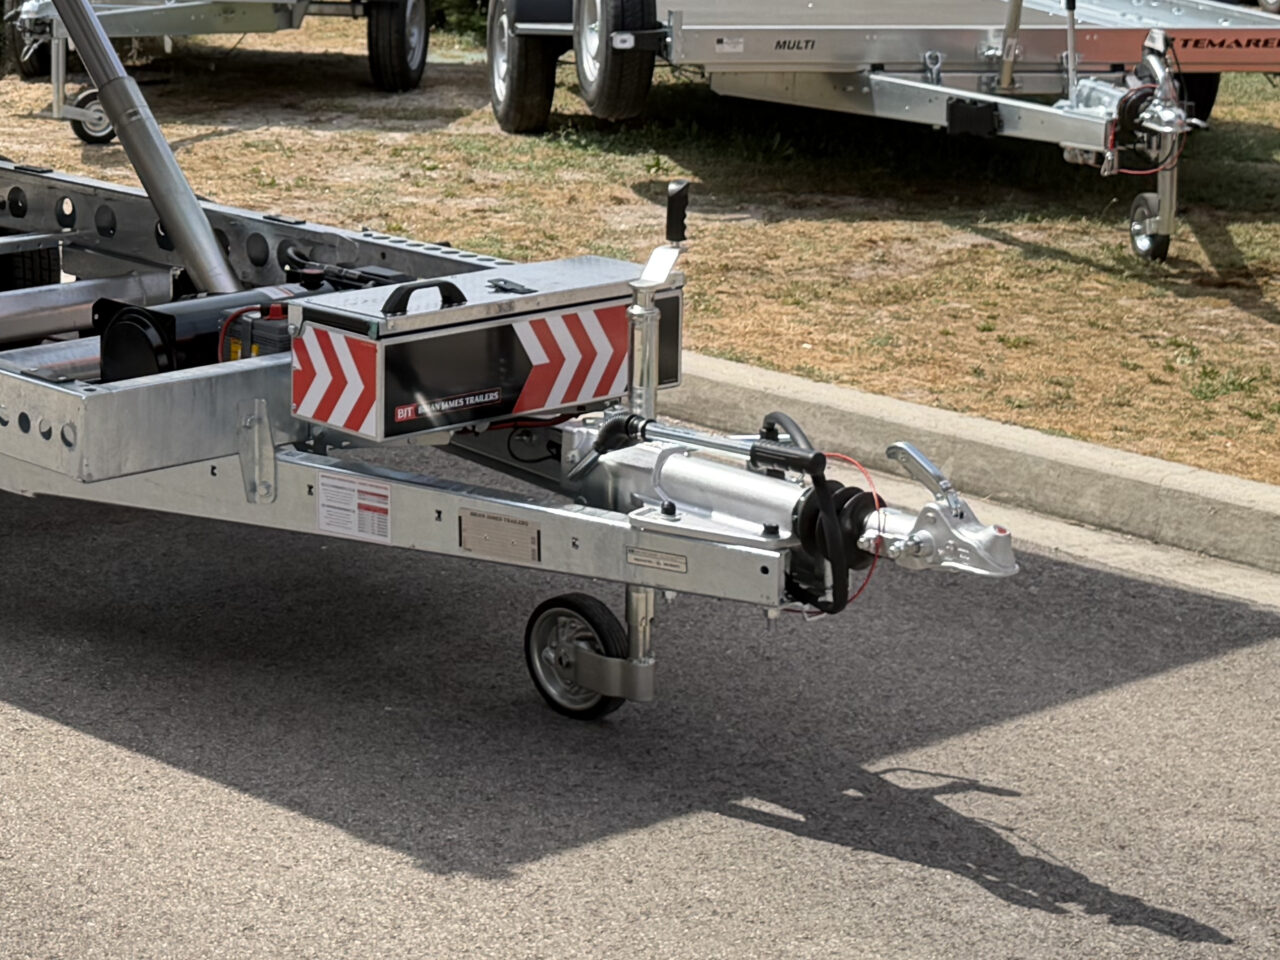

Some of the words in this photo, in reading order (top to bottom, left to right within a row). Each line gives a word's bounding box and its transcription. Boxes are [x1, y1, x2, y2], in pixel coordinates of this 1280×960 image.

[774, 39, 816, 50] MULTI
[1180, 38, 1280, 49] TEMARE
[397, 407, 413, 419] BJT
[441, 397, 464, 410] JAMES
[465, 391, 499, 405] TRAILERS
